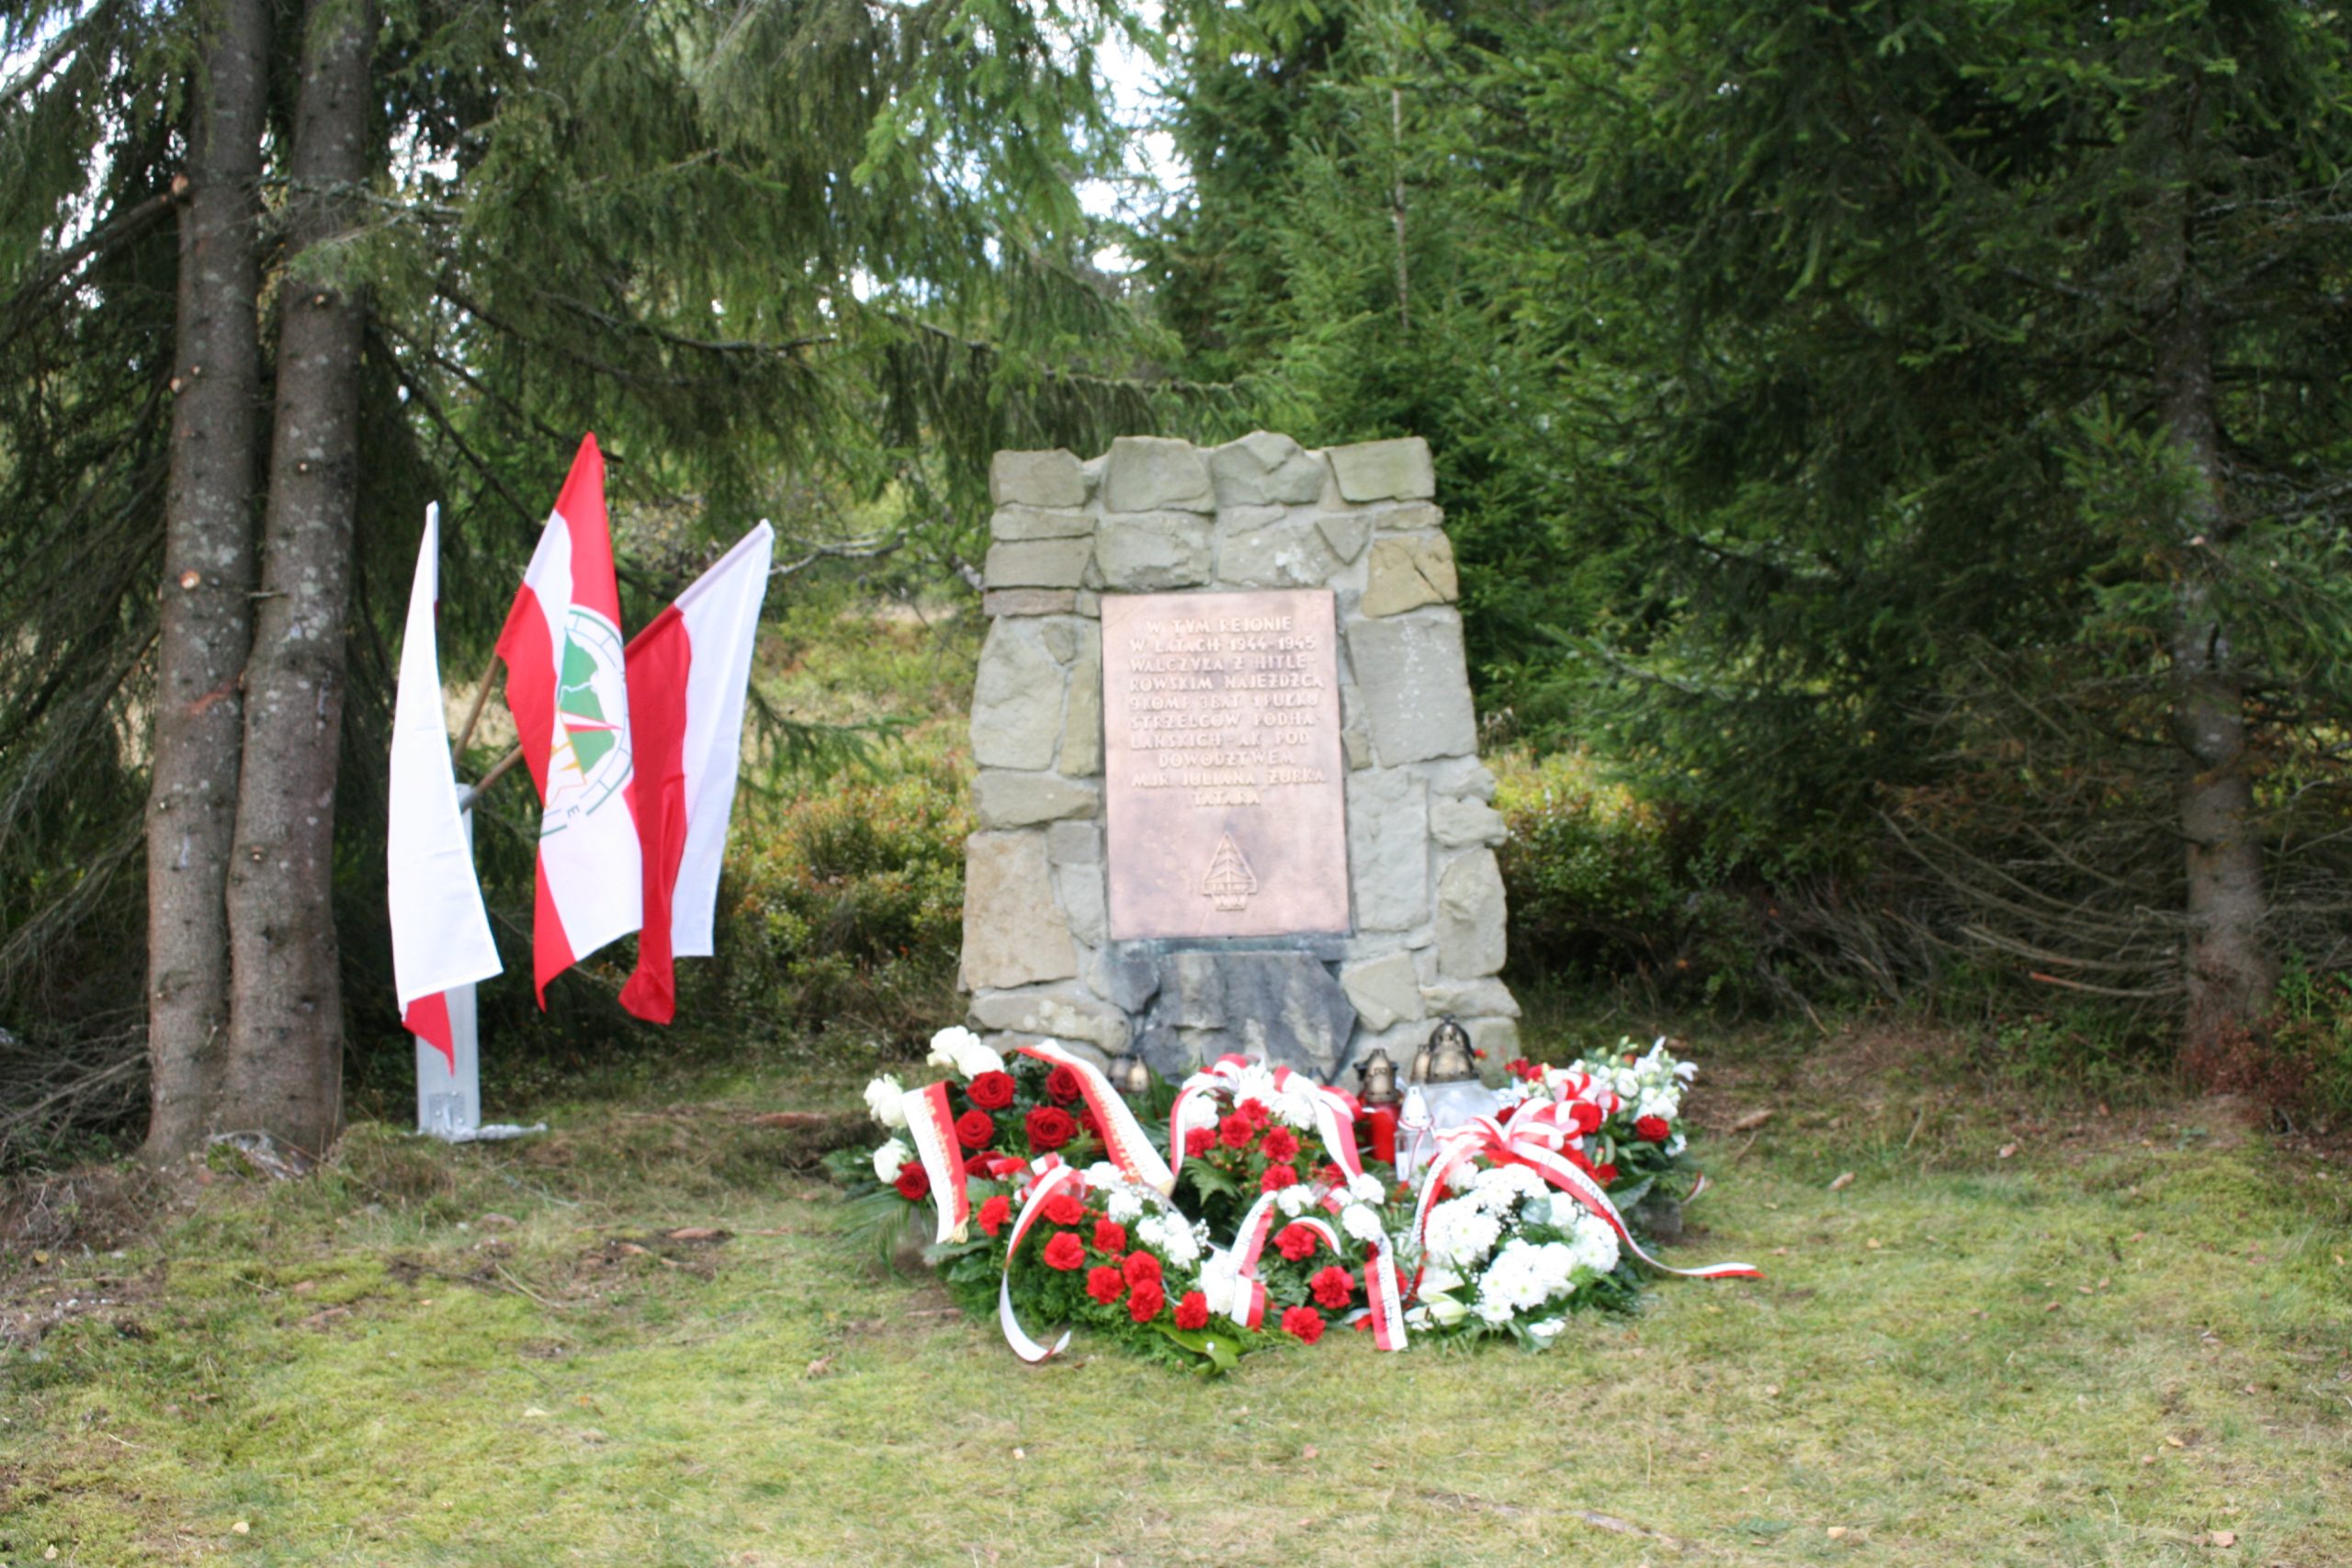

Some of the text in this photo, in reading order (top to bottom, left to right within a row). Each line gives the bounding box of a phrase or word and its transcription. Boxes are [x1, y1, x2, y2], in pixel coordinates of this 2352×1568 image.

[1147, 616, 1292, 634] W TYM REJONIE
[1130, 638, 1145, 652] W
[1155, 637, 1222, 653] LATACH
[1129, 675, 1214, 692] ROWSKIM
[1238, 731, 1261, 747] AK
[1274, 730, 1309, 746] POD
[1182, 770, 1256, 787] JULIANA
[1192, 790, 1261, 806] TATARA
[566, 805, 581, 819] E
